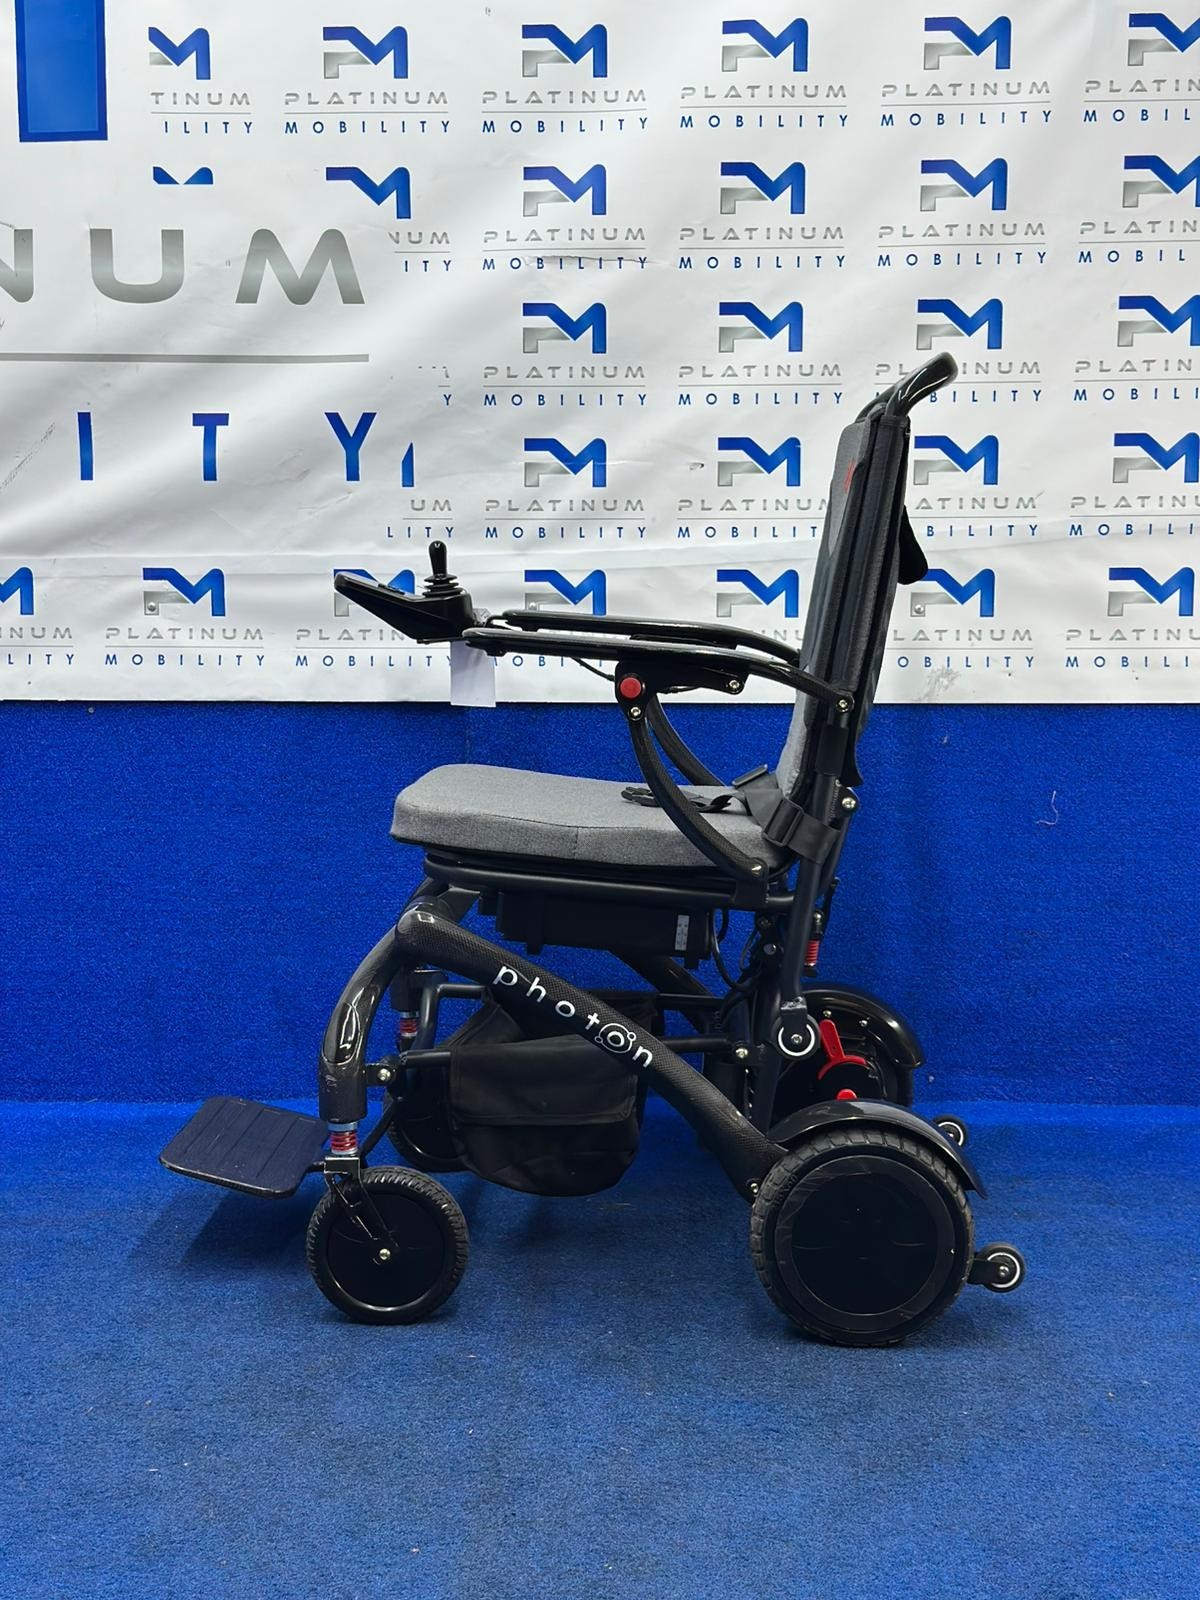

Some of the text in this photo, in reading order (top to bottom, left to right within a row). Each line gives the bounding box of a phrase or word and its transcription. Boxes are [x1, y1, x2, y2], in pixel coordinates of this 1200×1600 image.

[681, 85, 846, 99] PLATINUM
[882, 81, 1050, 97] PLATINUM
[151, 92, 250, 105] TINUM
[285, 92, 447, 105] PLATINUM
[483, 90, 645, 104] PLATINUM
[680, 115, 847, 128] MOBILITY
[881, 110, 1051, 126] MOBILITY
[1084, 109, 1190, 122] MOBIL
[165, 121, 252, 134] ILITY
[285, 121, 449, 134] MOBILITY
[483, 118, 647, 133] MOBILITY
[680, 227, 843, 240] PLATINUM
[879, 223, 1045, 238] PLATINUM
[1080, 220, 1197, 234] PLATIN
[484, 228, 645, 243] PLATINUM
[679, 256, 845, 269] MOBILITY
[878, 252, 1046, 266] MOBILITY
[1079, 249, 1185, 263] MOBIL
[405, 260, 451, 272] ITY
[483, 256, 647, 270] MOBILITY
[484, 366, 644, 378] PLATINUM
[679, 364, 841, 378] PLATINUM
[1075, 359, 1192, 373] PLATIN
[484, 394, 646, 406] MOBILITY
[679, 392, 842, 405] MOBILITY
[1074, 388, 1198, 400] MOBILI
[77, 412, 377, 481] ITY
[486, 499, 644, 511] PLATINUM
[915, 496, 1037, 511] ATINUM
[388, 527, 453, 538] LITY
[486, 527, 645, 538] MOBILITY
[678, 526, 817, 538] MOBILIT
[927, 524, 1037, 537] BILITY
[1069, 524, 1193, 536] MOBILI
[106, 628, 263, 640] PLATINUM
[894, 629, 1032, 641] LATINUM
[8, 654, 74, 664] LITY
[105, 654, 264, 666] MOBILITY
[898, 656, 1033, 668] OBILITY
[1066, 656, 1188, 667] MOBILI
[493, 966, 653, 1068] photon
